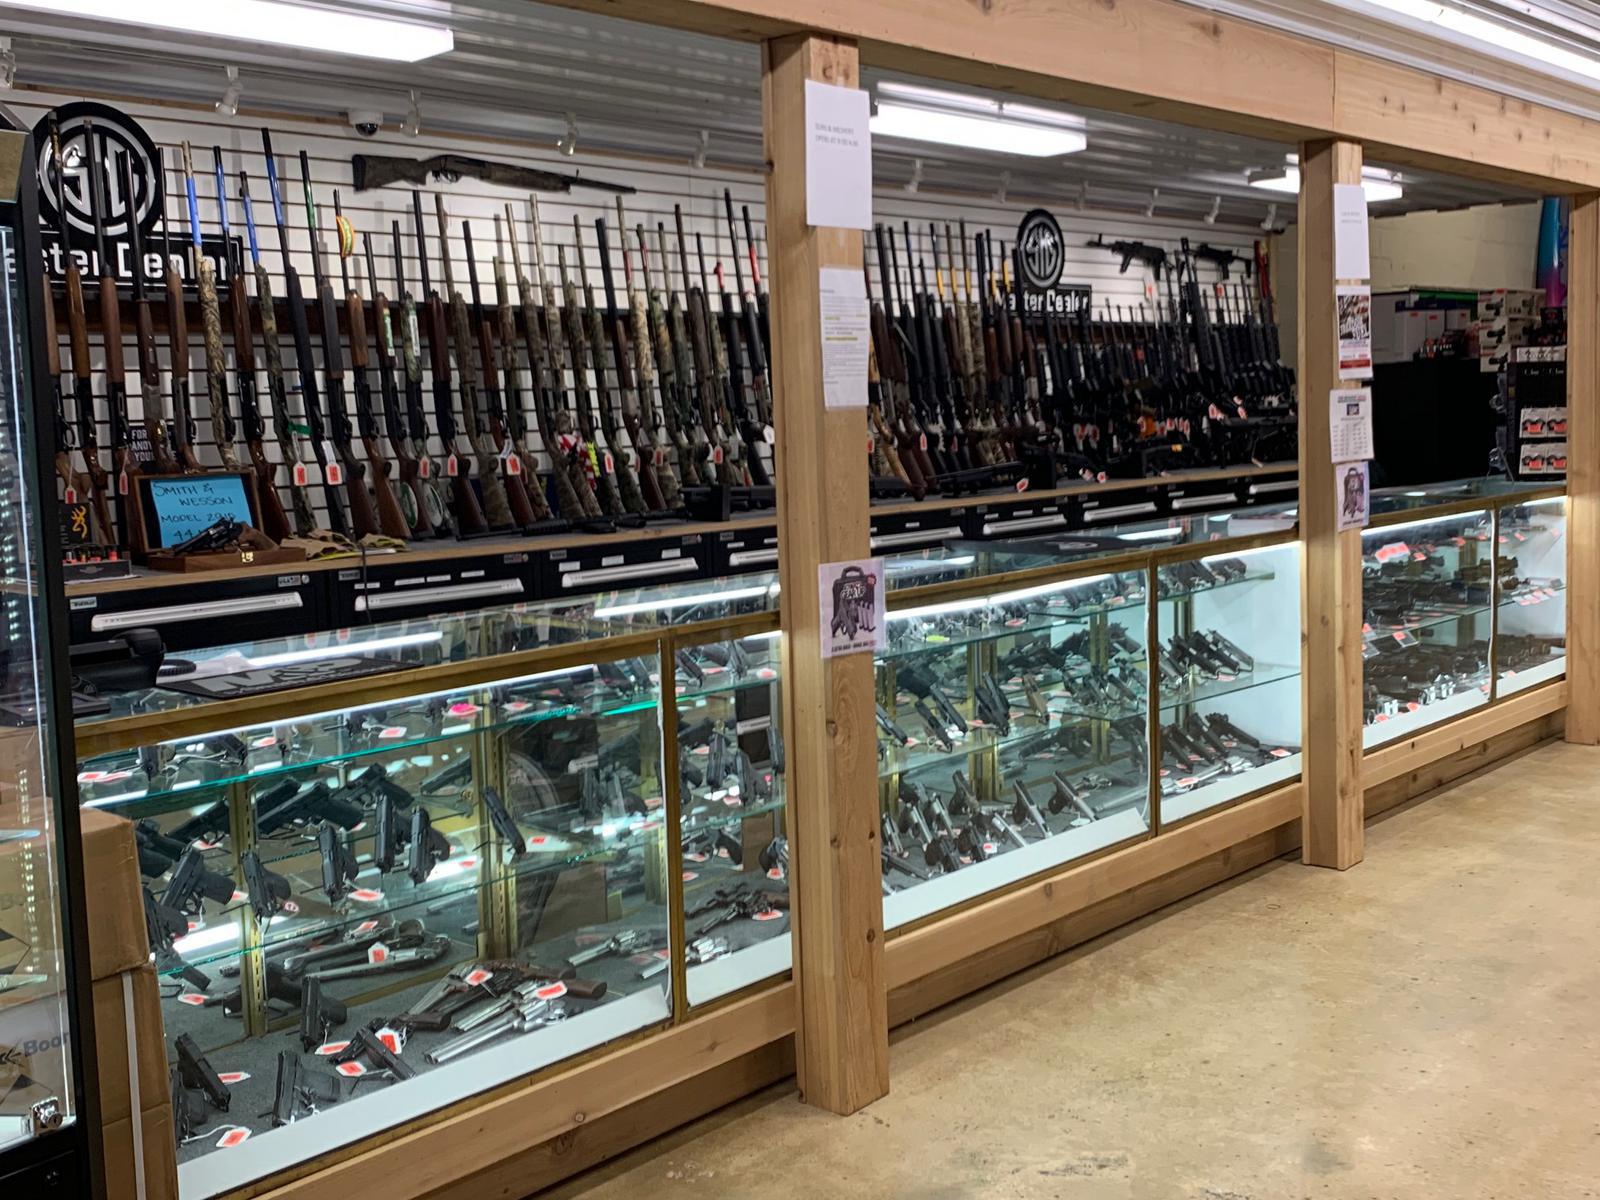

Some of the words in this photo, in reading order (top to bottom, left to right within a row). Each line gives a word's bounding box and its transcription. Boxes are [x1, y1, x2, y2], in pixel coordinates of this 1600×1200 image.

[131, 429, 148, 440] FOR
[153, 481, 198, 497] SMITH
[178, 496, 234, 507] WESSON
[160, 513, 202, 523] MODEL
